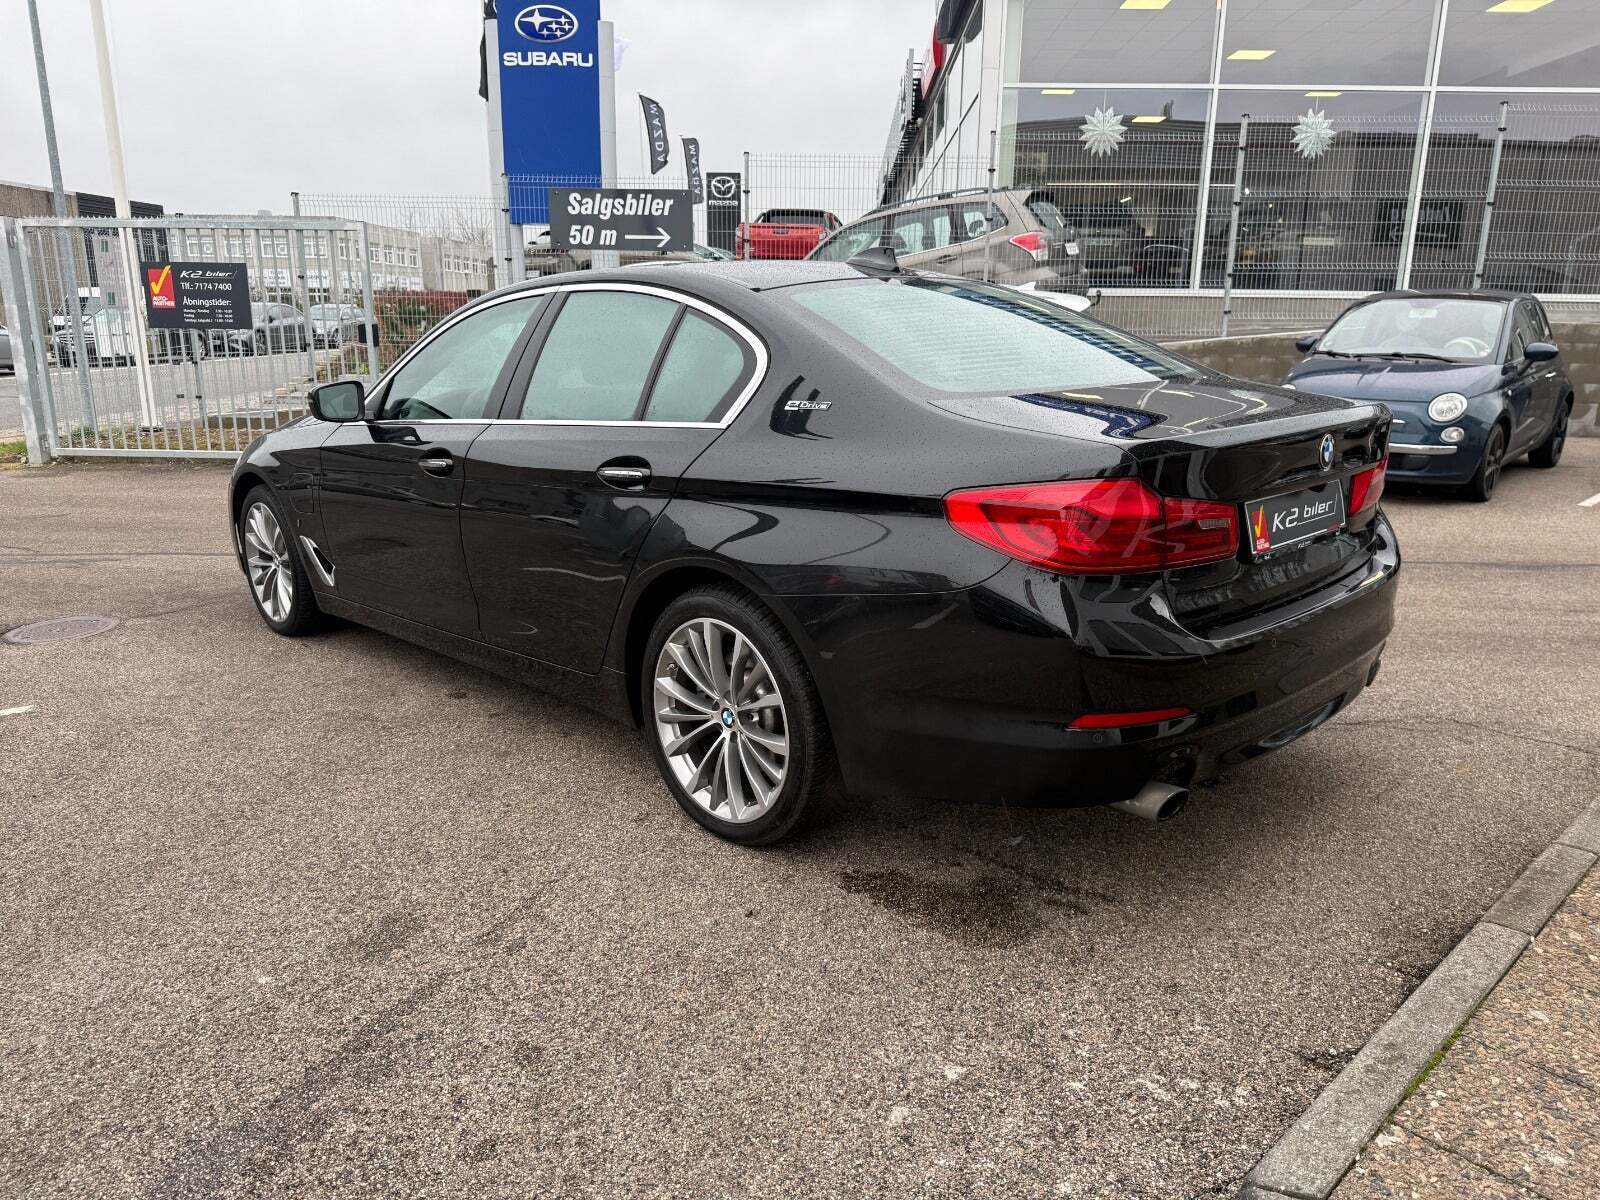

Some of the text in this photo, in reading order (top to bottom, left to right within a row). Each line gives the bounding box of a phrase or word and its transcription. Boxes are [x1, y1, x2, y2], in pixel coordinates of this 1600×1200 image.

[503, 51, 593, 67] SUBARU
[567, 192, 674, 220] Salgsbiler
[568, 224, 618, 246] 50 m
[180, 270, 233, 279] K2 biler
[195, 282, 213, 291] 7174
[214, 283, 232, 291] 7400
[182, 296, 232, 307] Åbningstider:
[1272, 500, 1333, 533] K2 biler
